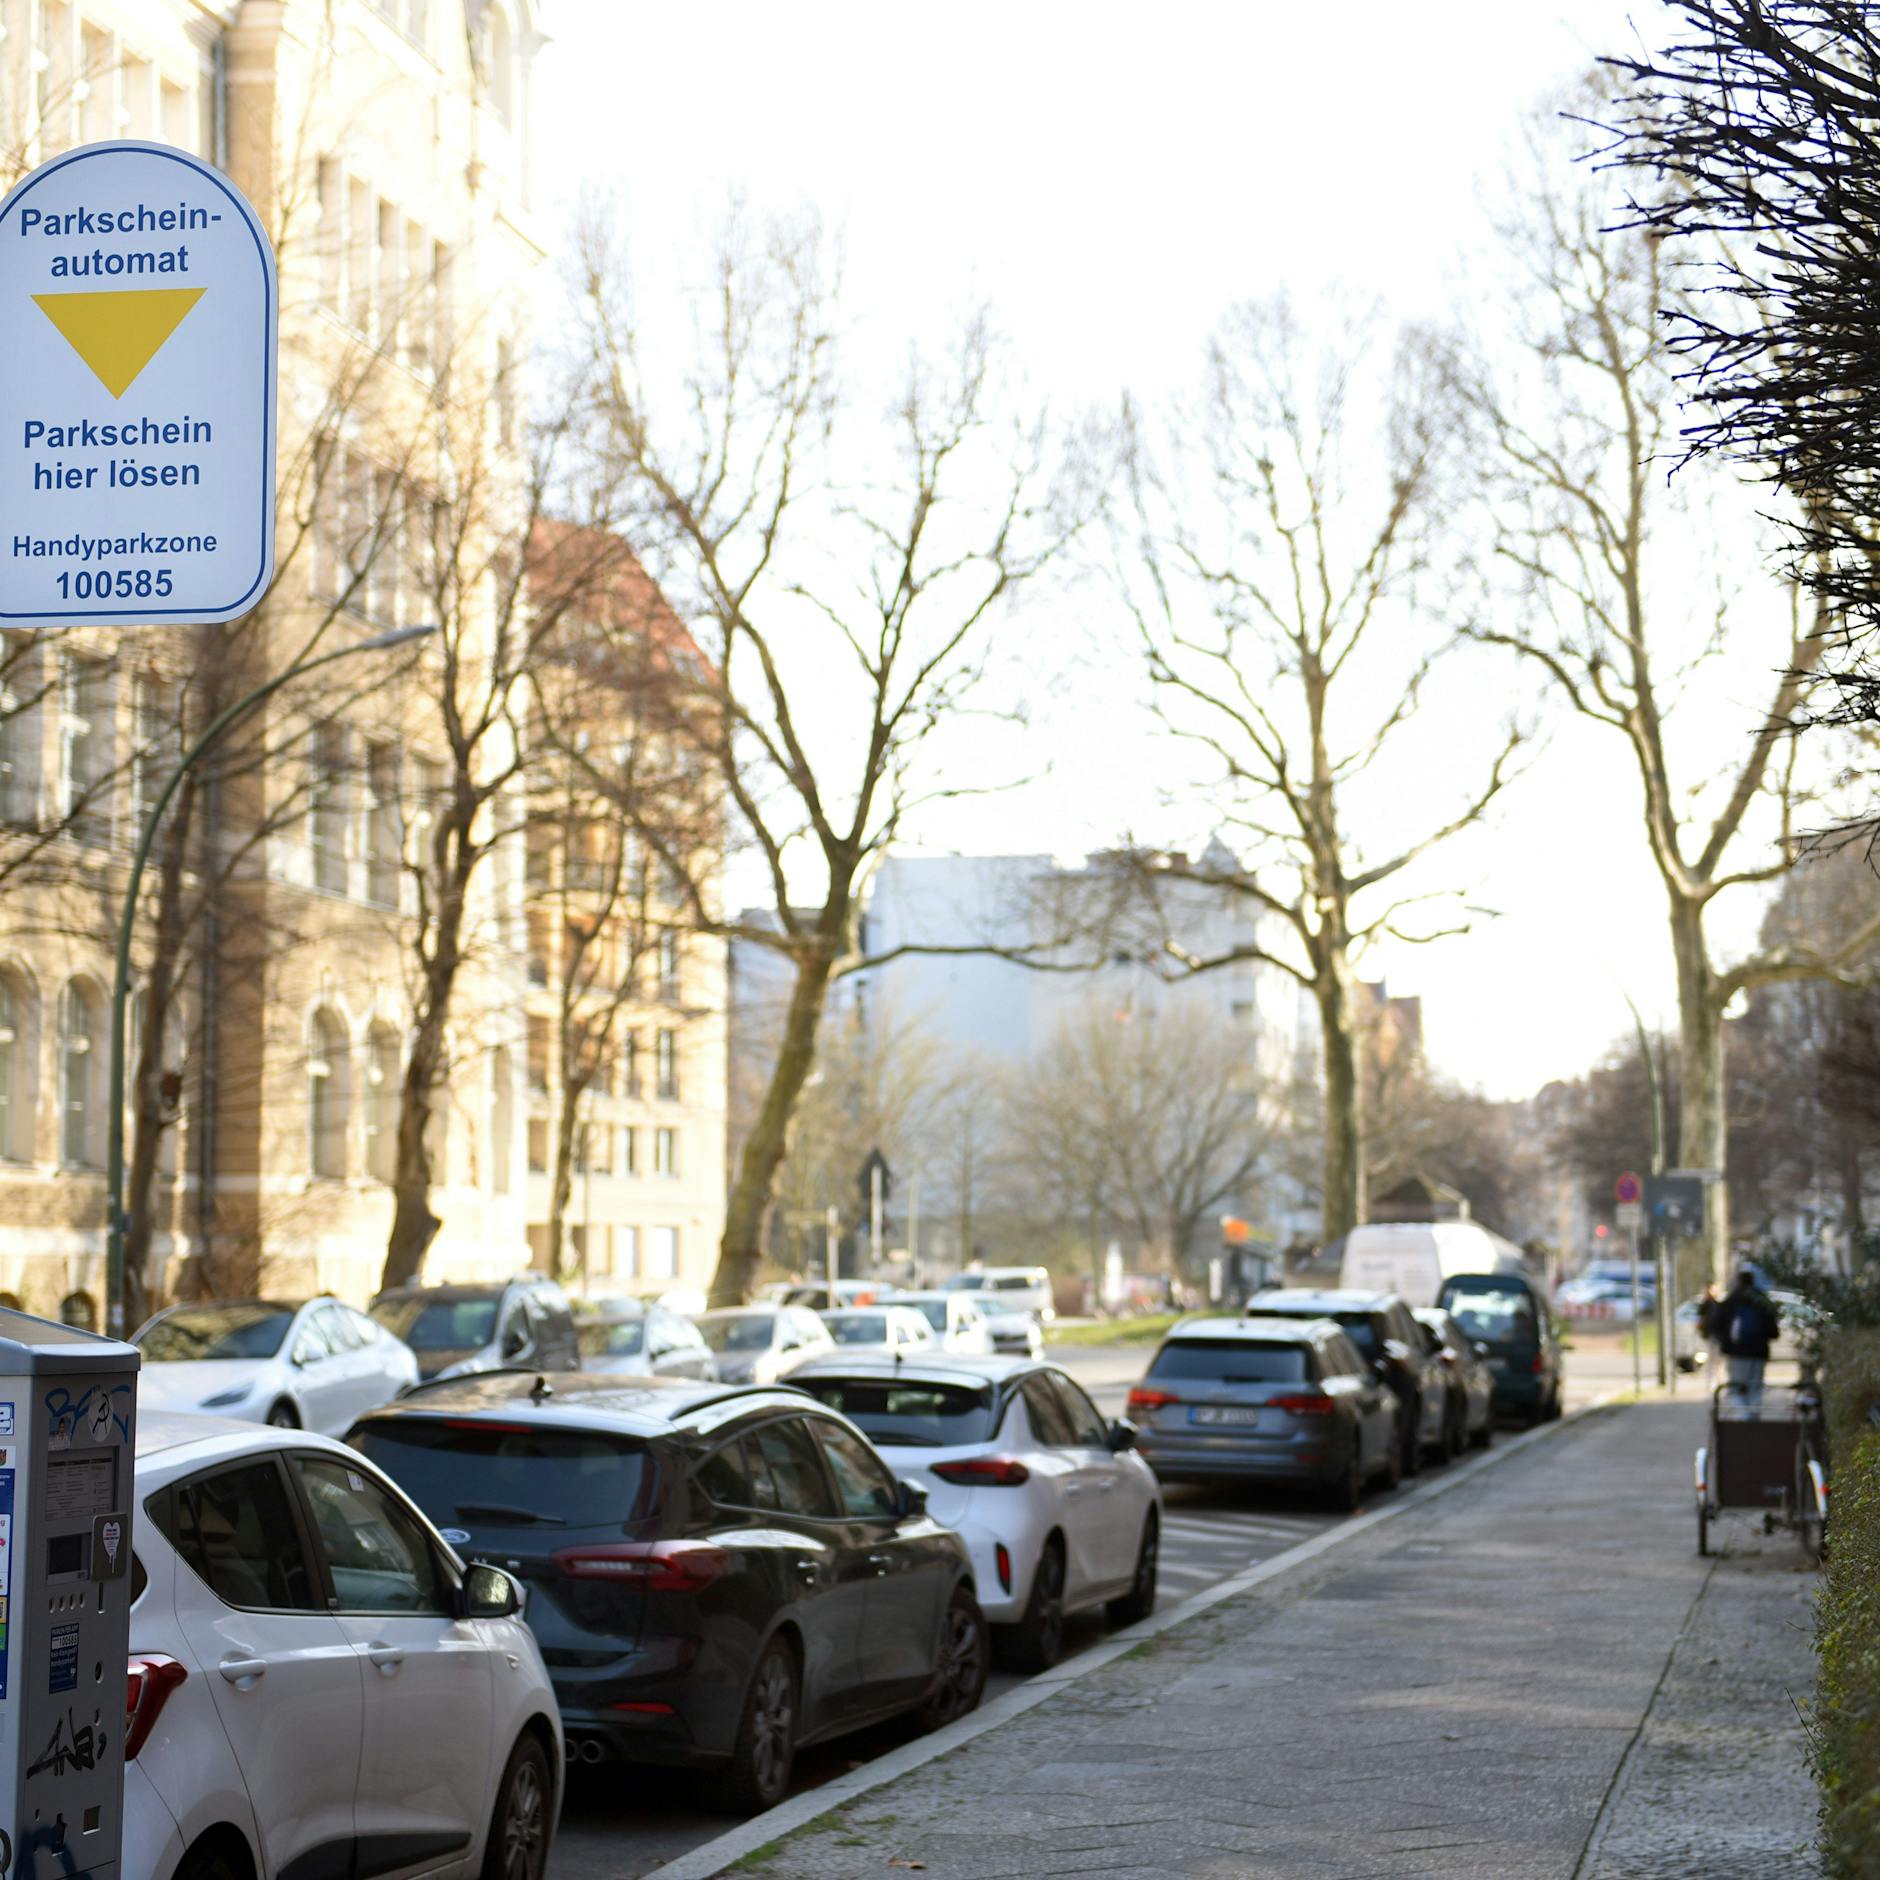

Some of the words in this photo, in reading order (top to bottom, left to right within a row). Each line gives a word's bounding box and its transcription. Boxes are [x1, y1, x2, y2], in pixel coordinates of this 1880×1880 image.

[21, 202, 222, 237] Parkschein-
[51, 245, 189, 277] automat
[24, 415, 212, 448] Parkschein
[34, 462, 98, 490] hier
[109, 459, 200, 489] lösen
[13, 531, 217, 561] Handyparkzone
[56, 569, 173, 600] 100585
